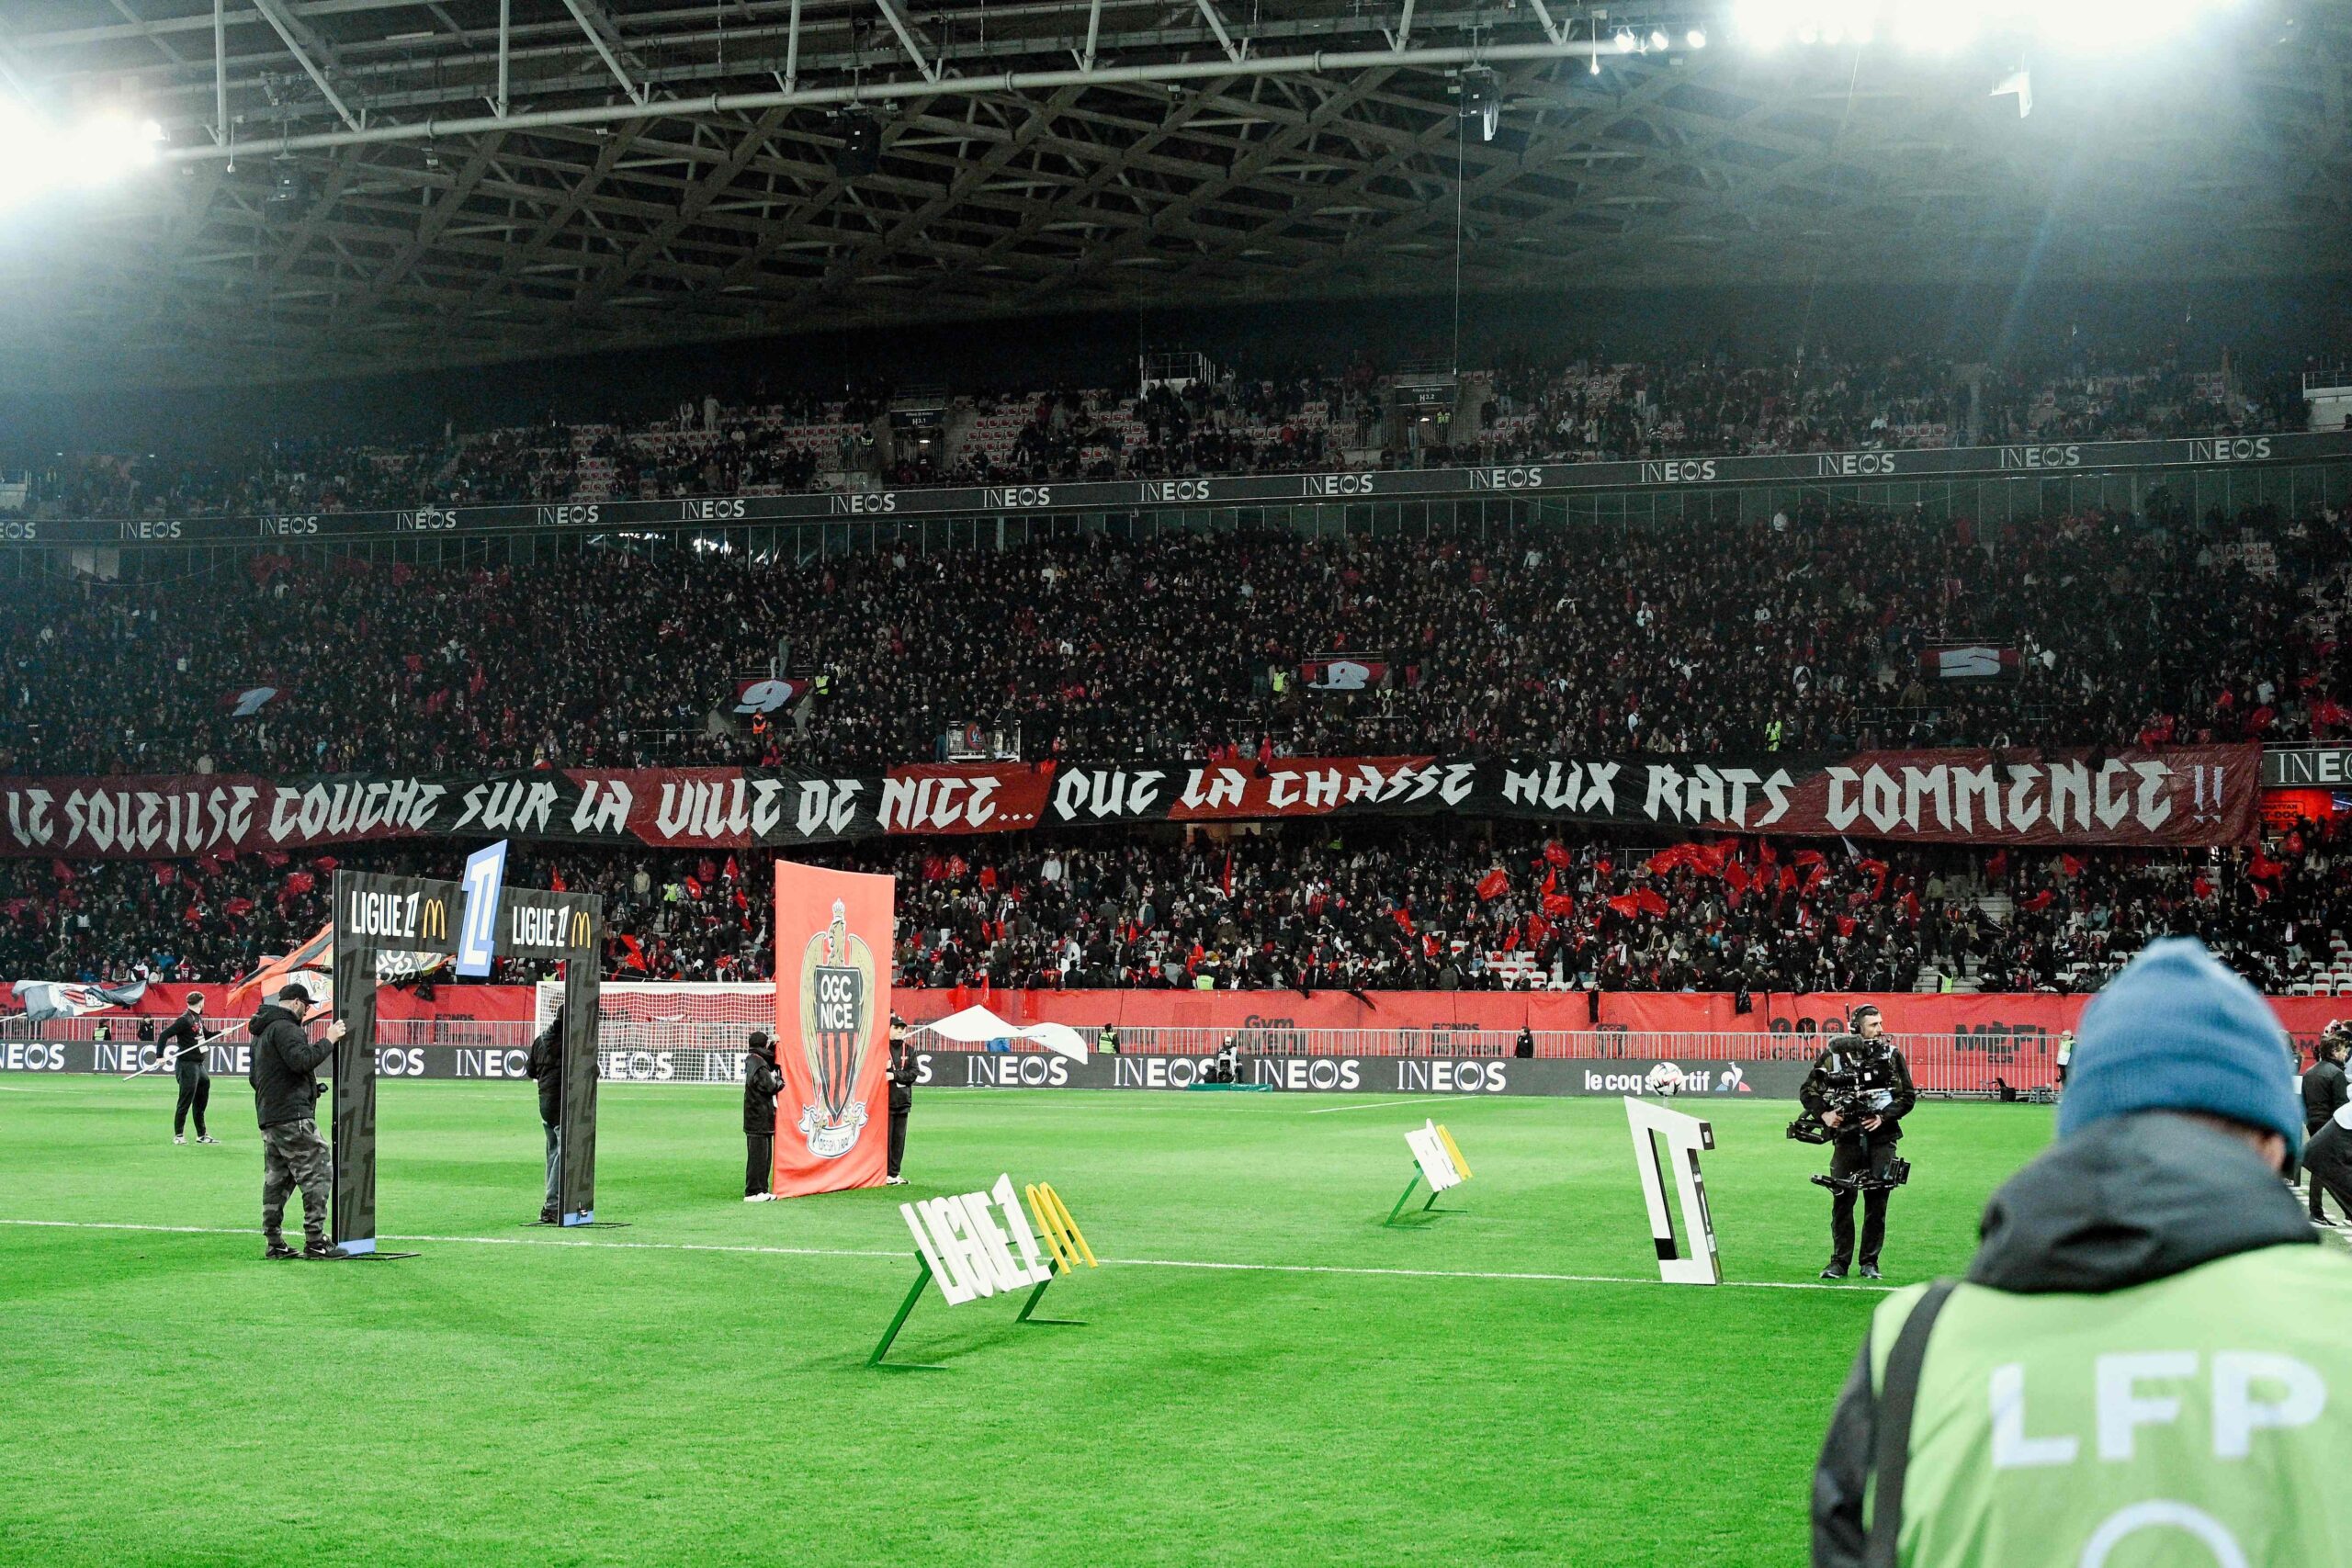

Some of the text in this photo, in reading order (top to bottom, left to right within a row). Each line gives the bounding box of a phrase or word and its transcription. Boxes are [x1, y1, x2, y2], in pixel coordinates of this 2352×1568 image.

[2000, 446, 2080, 468] INEOS
[2188, 437, 2271, 463] INEOS
[1640, 460, 1716, 483] INEOS
[1817, 453, 1895, 476] INEOS
[1303, 474, 1374, 496] INEOS
[1469, 468, 1542, 489] INEOS
[983, 487, 1051, 508] INEOS
[1141, 480, 1210, 502] INEOS
[682, 499, 746, 520] INEOS
[831, 493, 895, 514] INEOS
[260, 516, 318, 536] INEOS
[396, 511, 457, 531] INEOS
[537, 505, 599, 525] INEOS
[120, 521, 182, 539] INEOS
[7, 789, 55, 849] LE
[267, 776, 447, 843] COUCHE
[451, 779, 558, 834] SUR
[571, 779, 634, 835] LA
[795, 778, 865, 838] DE
[1052, 766, 1167, 821] QUE
[1180, 768, 1247, 810] LA
[1267, 762, 1477, 808] CHASSE
[1643, 762, 1794, 829] RATS
[1825, 757, 2180, 834] COMMENCE
[820, 974, 853, 1002] OGC
[820, 1003, 854, 1029] NICE
[967, 1055, 1069, 1086] INEOS
[1253, 1058, 1360, 1090] INEOS
[1396, 1060, 1507, 1092] INEOS
[1585, 1069, 1711, 1095] le coq srtif
[1989, 1350, 2328, 1469] LFP
